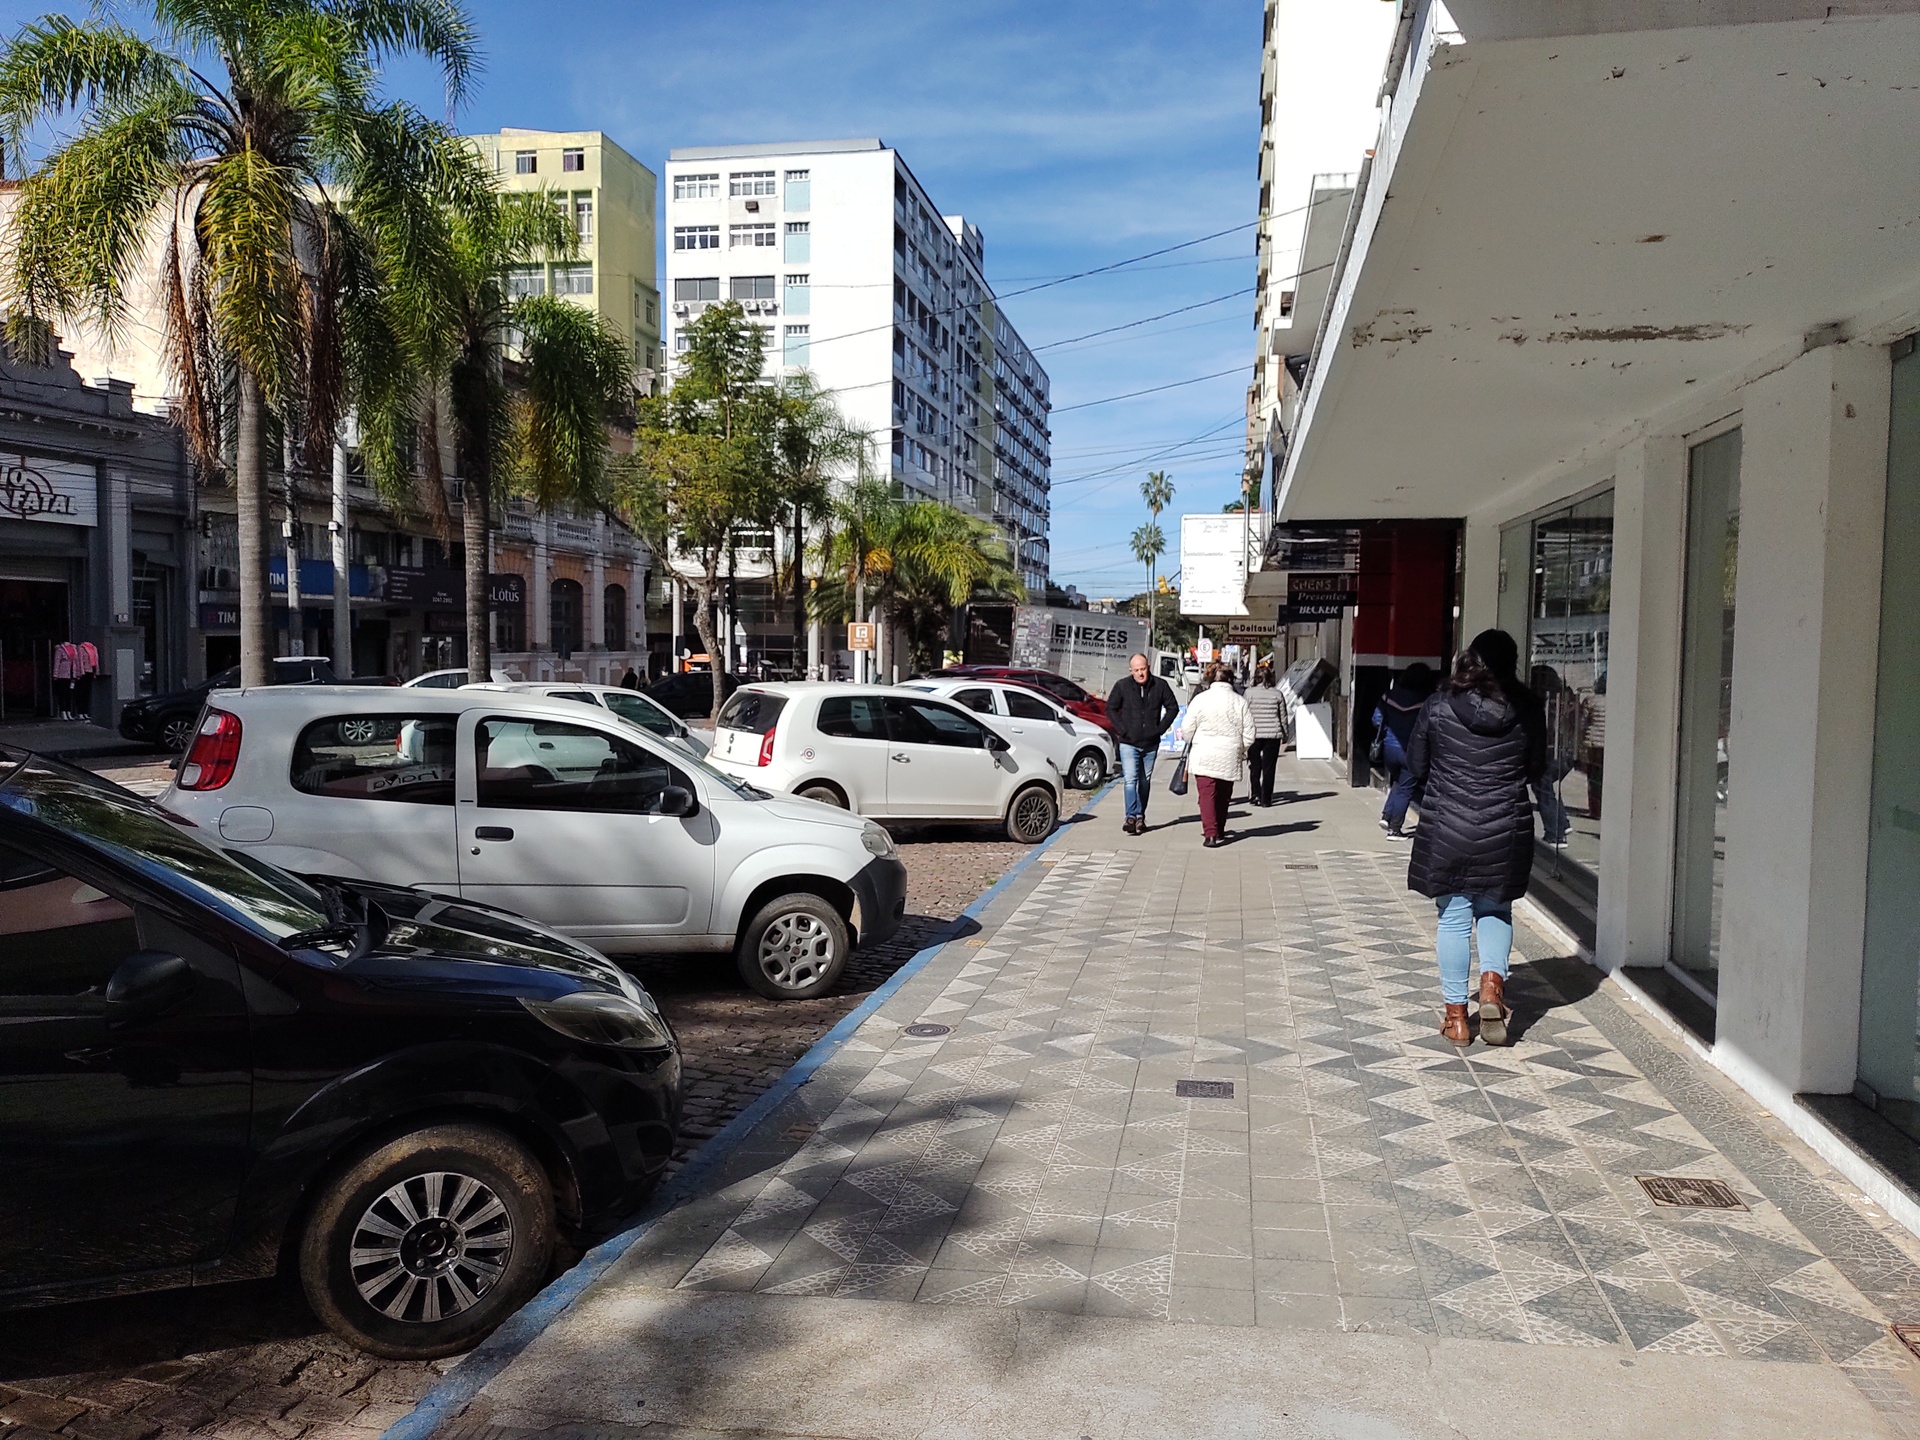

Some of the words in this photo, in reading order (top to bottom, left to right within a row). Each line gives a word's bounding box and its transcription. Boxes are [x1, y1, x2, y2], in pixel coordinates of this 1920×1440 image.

[10, 489, 77, 515] FATAL
[1298, 592, 1348, 601] Presentes
[1298, 605, 1339, 615] BECKER
[217, 611, 236, 624] TIM
